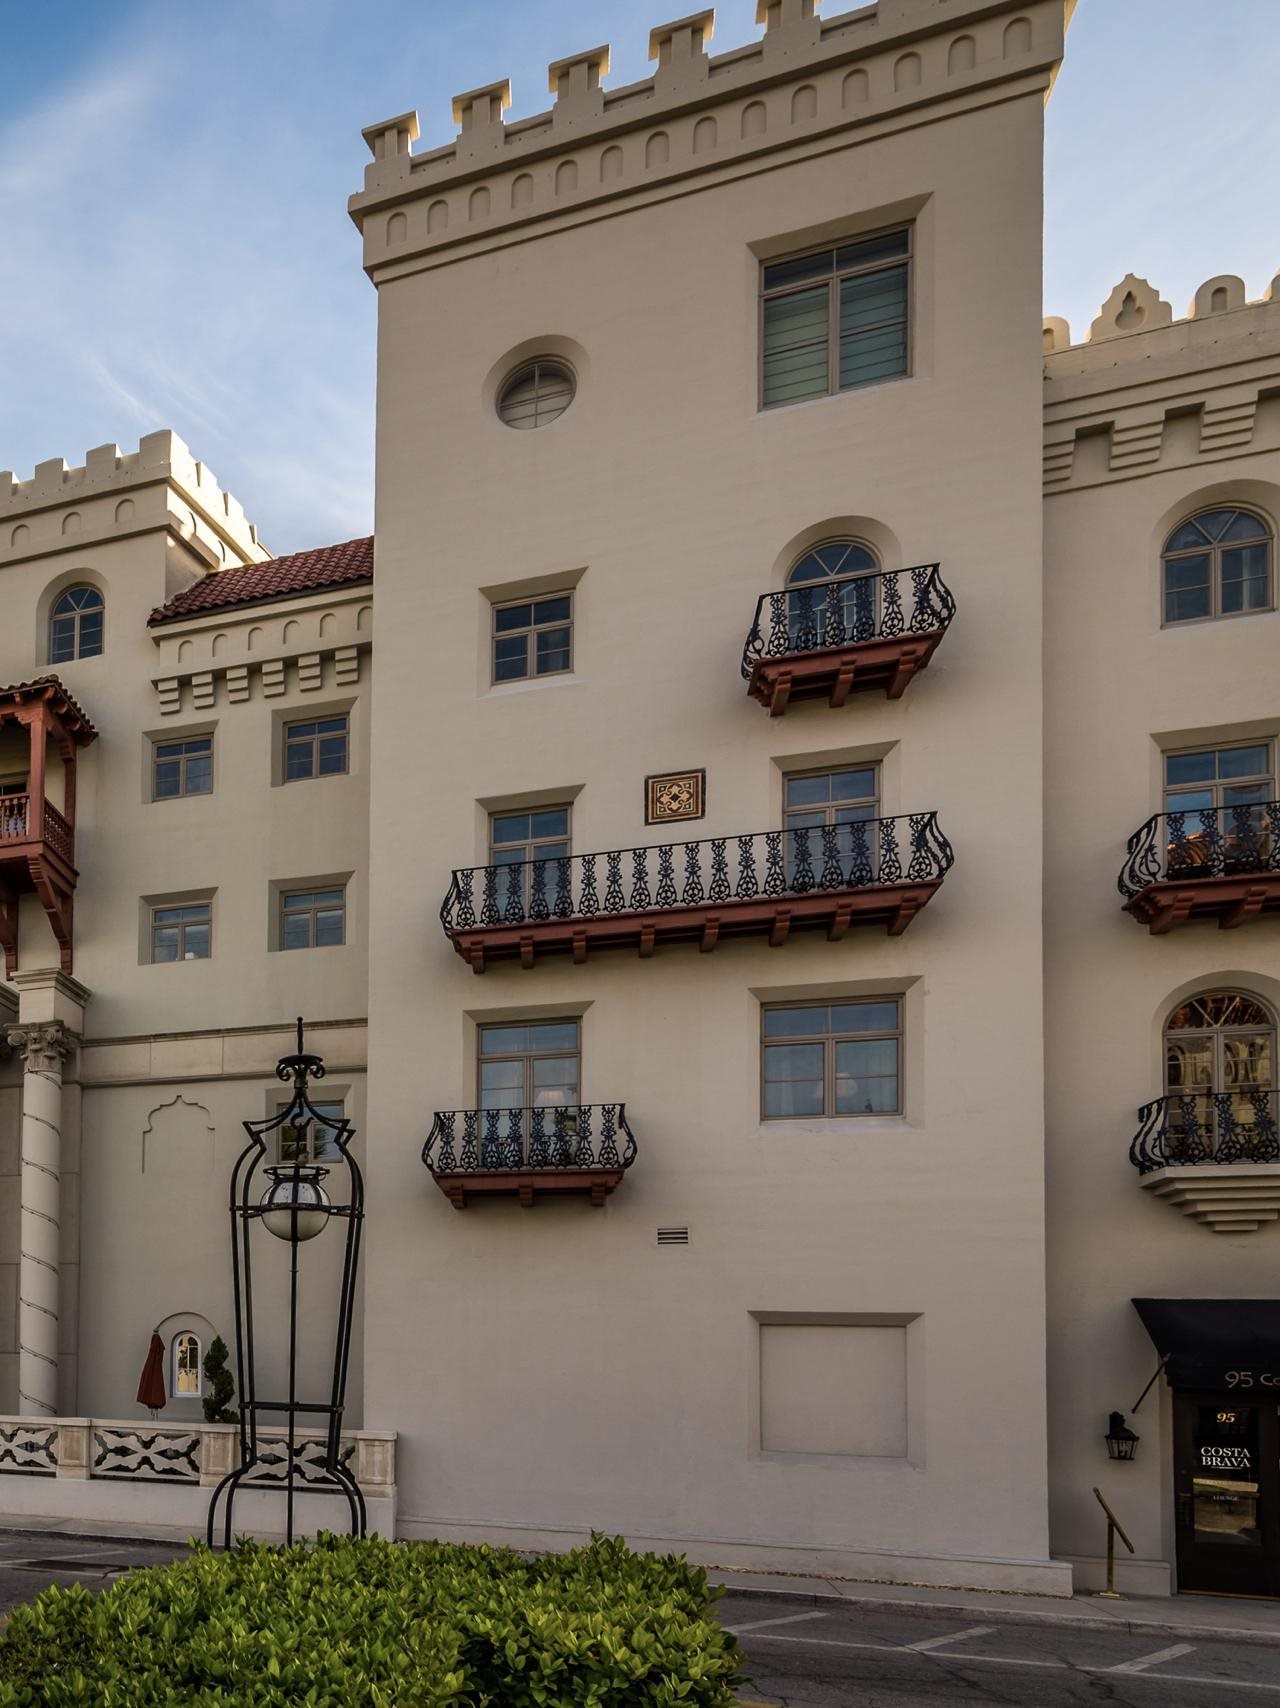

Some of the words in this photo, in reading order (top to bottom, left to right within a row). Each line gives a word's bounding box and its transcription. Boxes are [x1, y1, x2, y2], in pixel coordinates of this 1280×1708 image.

[1225, 1371, 1253, 1388] 95
[1216, 1412, 1236, 1423] 95
[1200, 1446, 1251, 1457] COSTA
[1202, 1456, 1250, 1467] BRAVA
